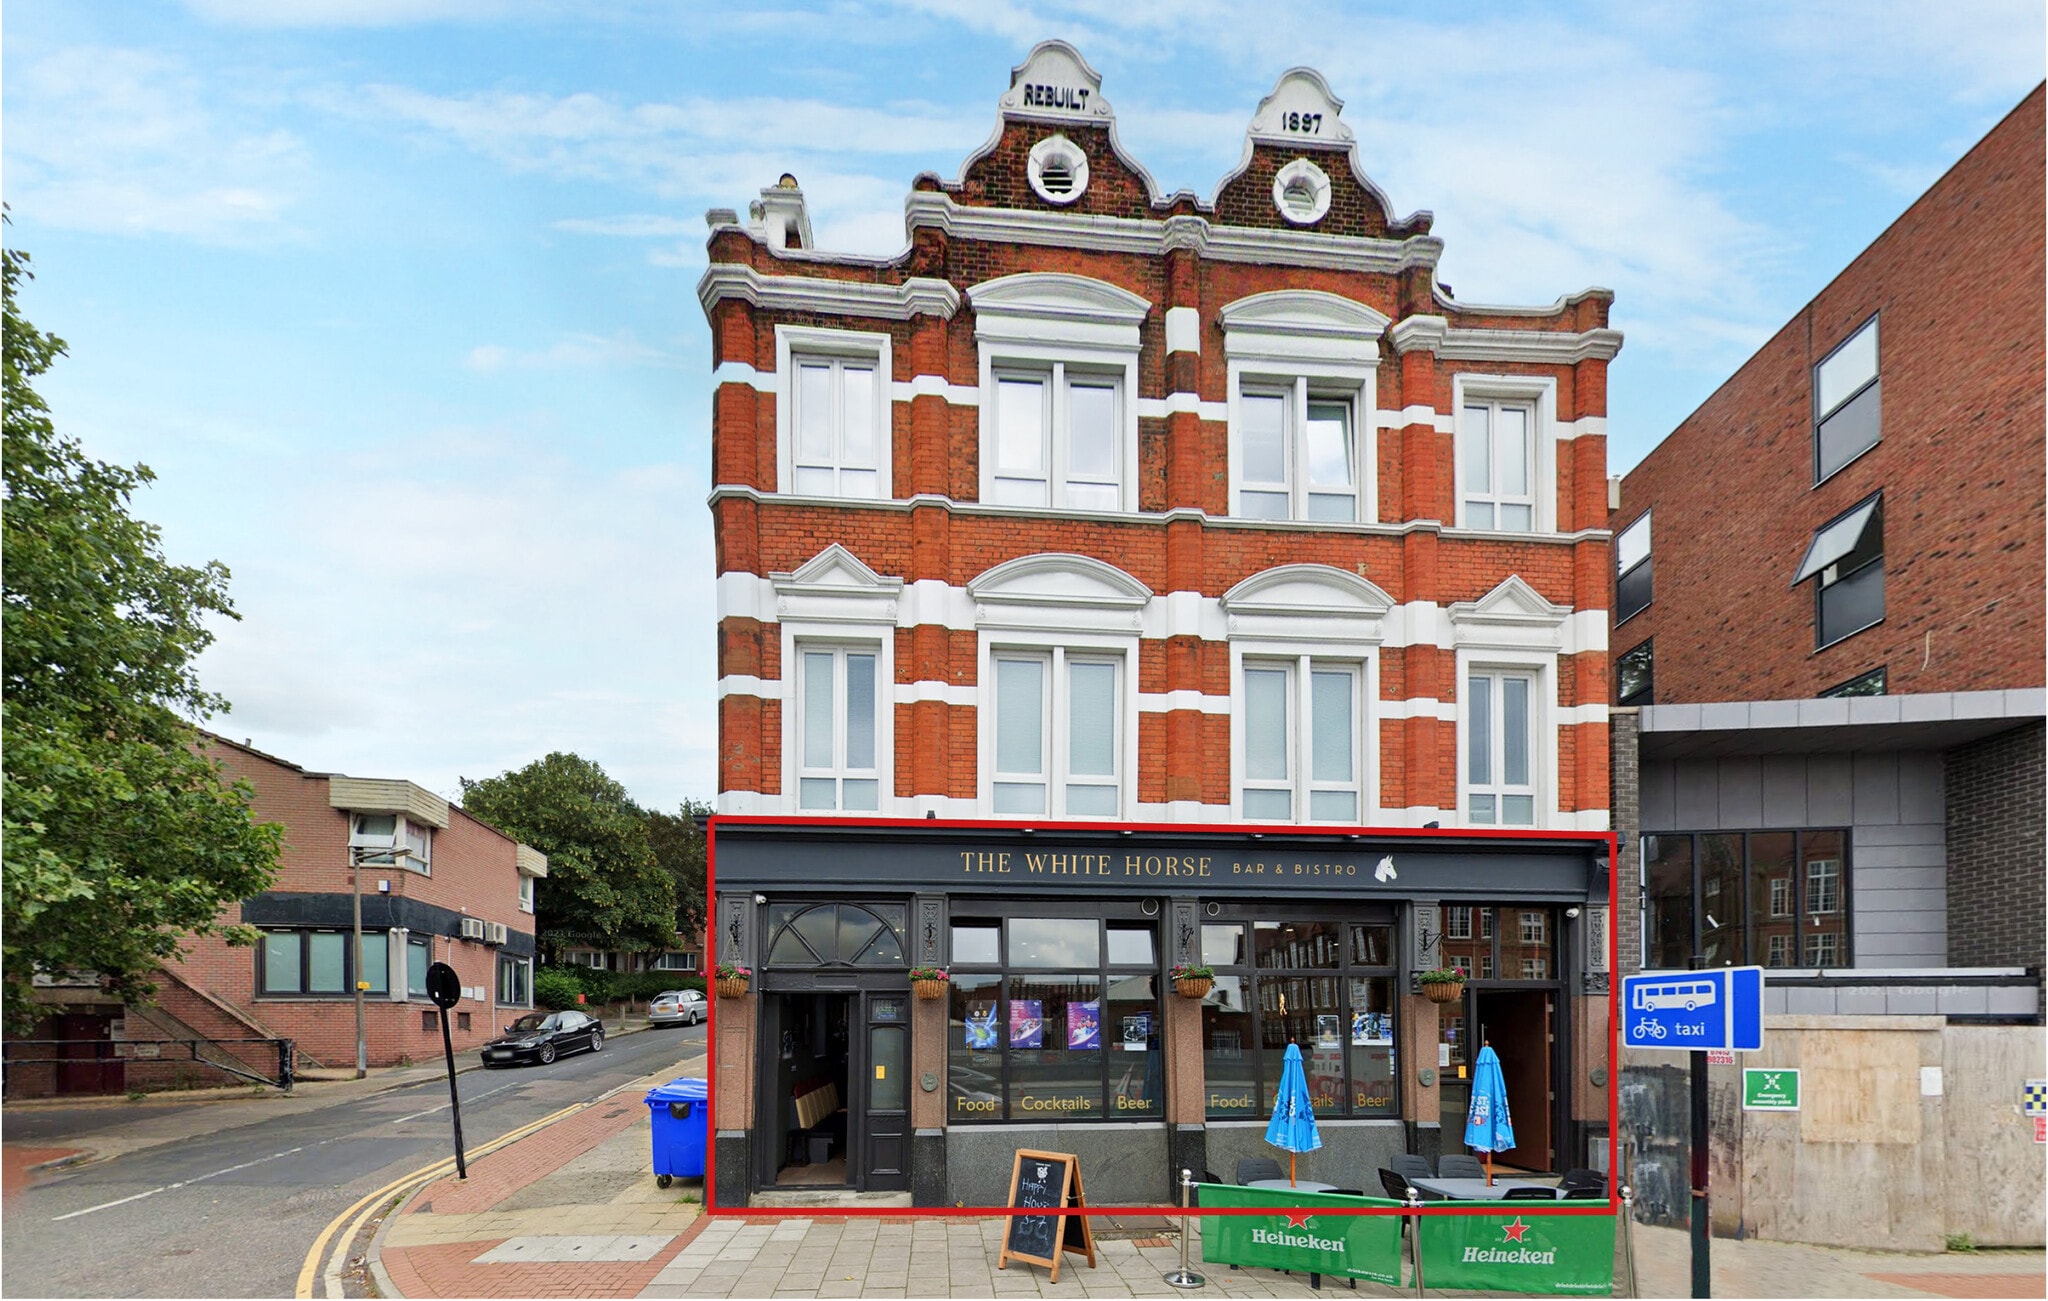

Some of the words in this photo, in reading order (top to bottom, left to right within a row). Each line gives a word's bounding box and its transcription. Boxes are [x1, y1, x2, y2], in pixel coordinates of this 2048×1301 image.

[1023, 83, 1090, 111] REBUILT
[1281, 111, 1323, 135] 1897
[960, 852, 1012, 873] THE
[1025, 853, 1112, 875] WHITE
[1125, 856, 1212, 877] HORSE
[1232, 863, 1265, 874] BAR
[1275, 864, 1284, 874] &
[1294, 864, 1356, 876] BISTRO
[1674, 1022, 1706, 1037] taxi
[957, 1096, 995, 1112] Food
[1021, 1096, 1091, 1111] Cocktails
[1117, 1095, 1152, 1110] Beer
[1210, 1094, 1249, 1108] Food
[1357, 1093, 1389, 1108] Beer
[1252, 1229, 1345, 1252] Heineken
[1462, 1247, 1556, 1265] Heineken
